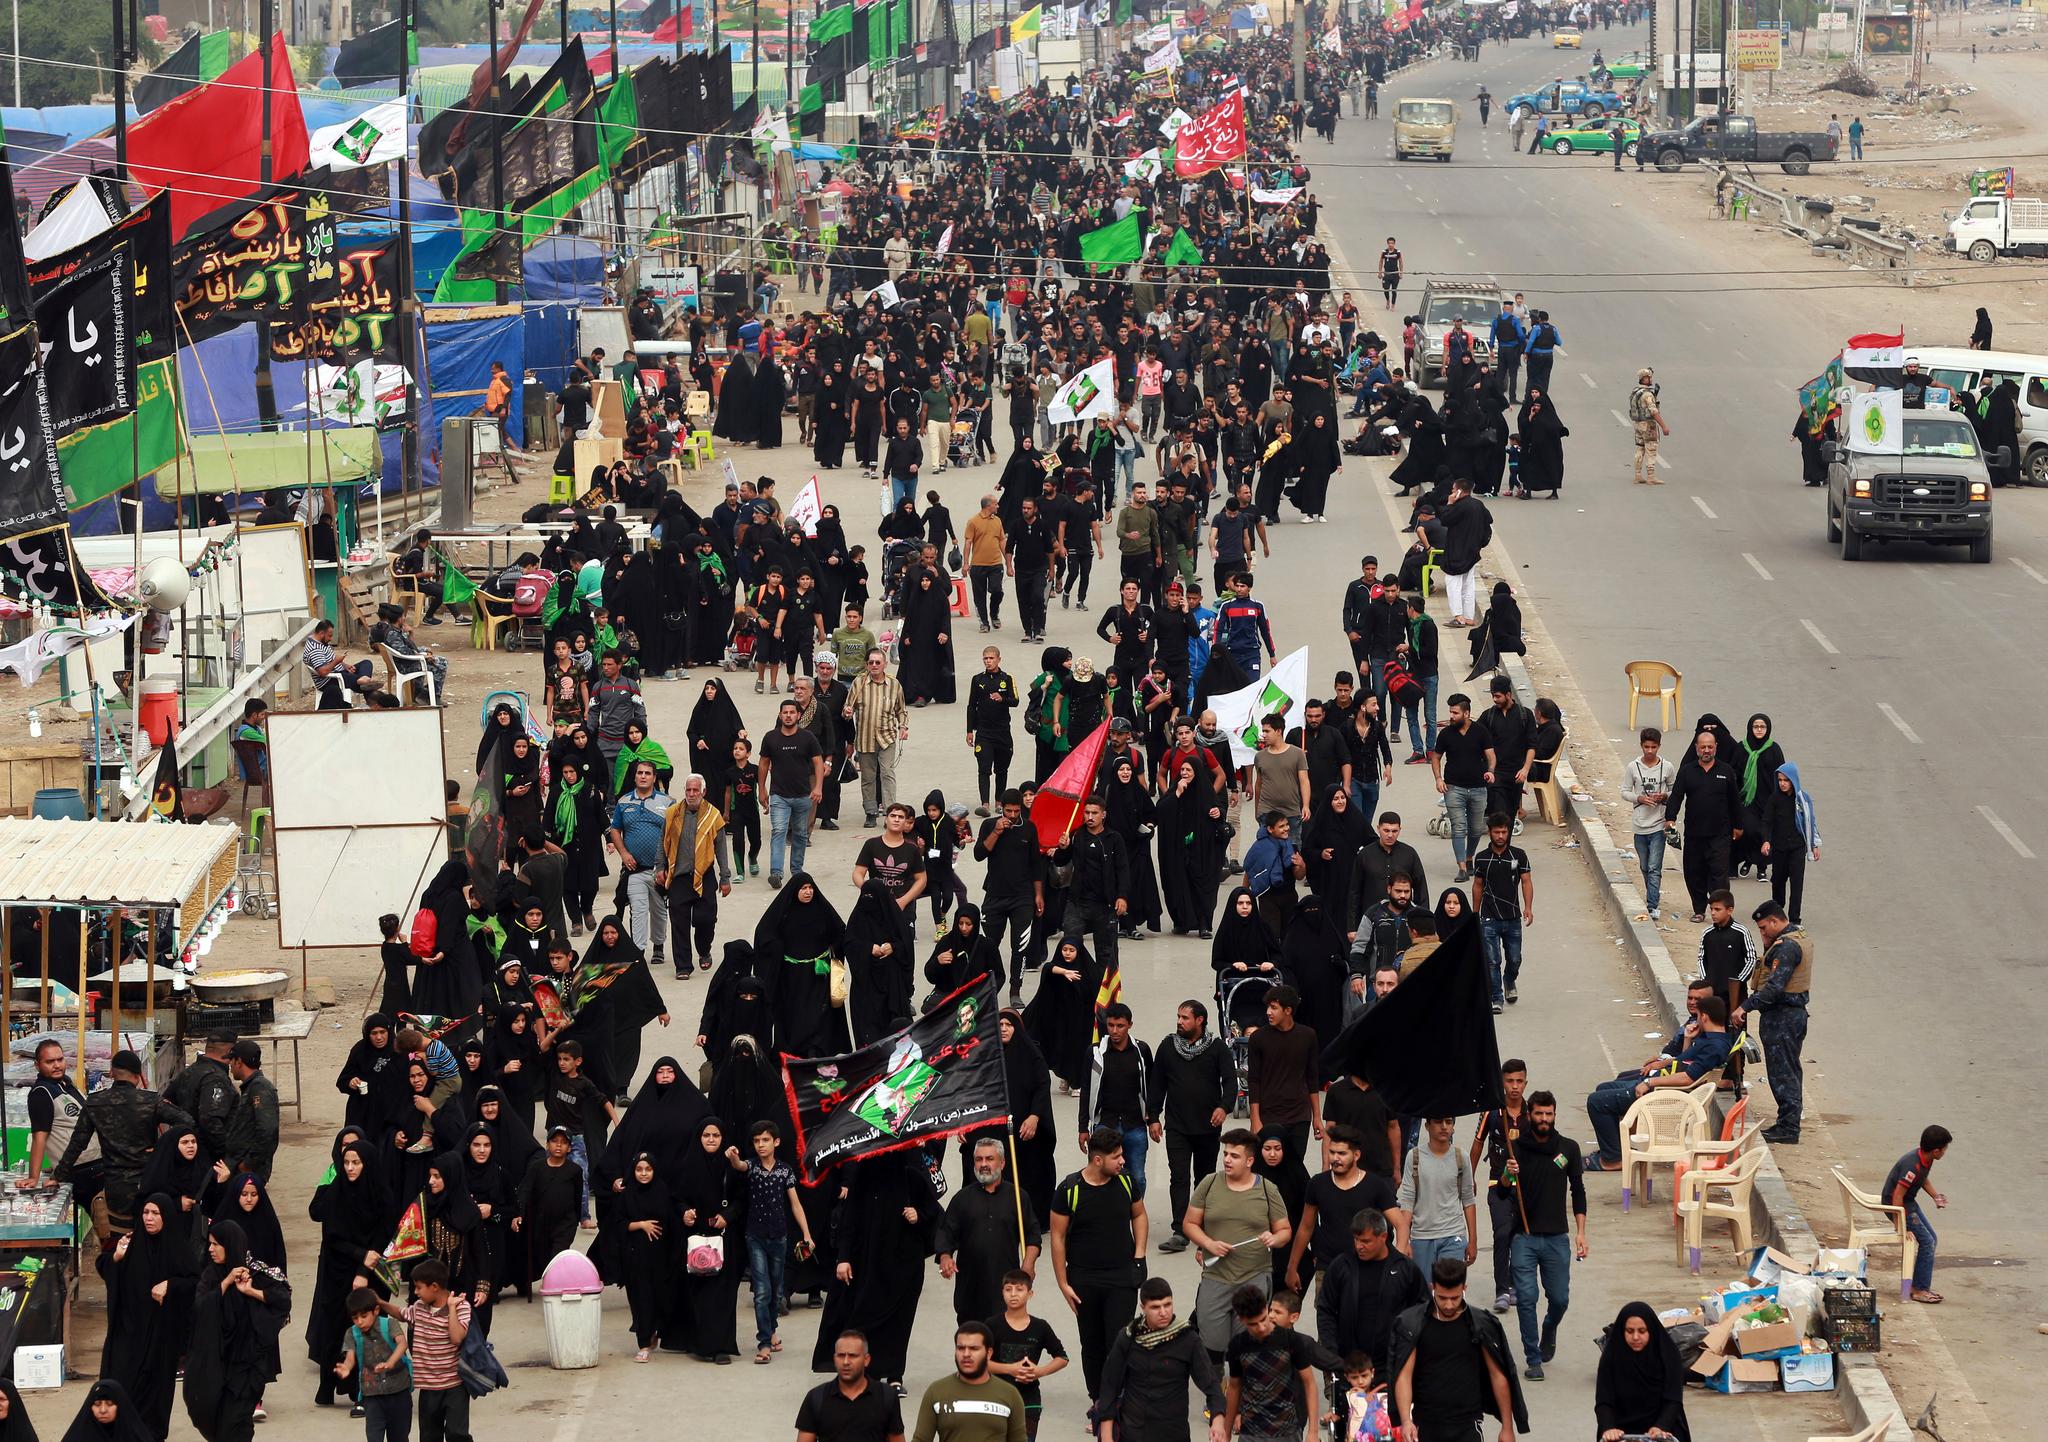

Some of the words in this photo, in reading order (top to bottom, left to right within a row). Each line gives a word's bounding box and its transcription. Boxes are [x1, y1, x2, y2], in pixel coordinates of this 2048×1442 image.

[1182, 119, 1199, 137] الله
[651, 268, 685, 281] موكب
[671, 283, 695, 299] كفيل
[68, 305, 102, 368] يا
[956, 1036, 980, 1059] حي
[939, 1108, 961, 1122] (ص)
[962, 1104, 988, 1117] محمد
[905, 1116, 939, 1132] رسول
[839, 1128, 881, 1151] الأنسانية
[814, 1143, 841, 1167] والسلام
